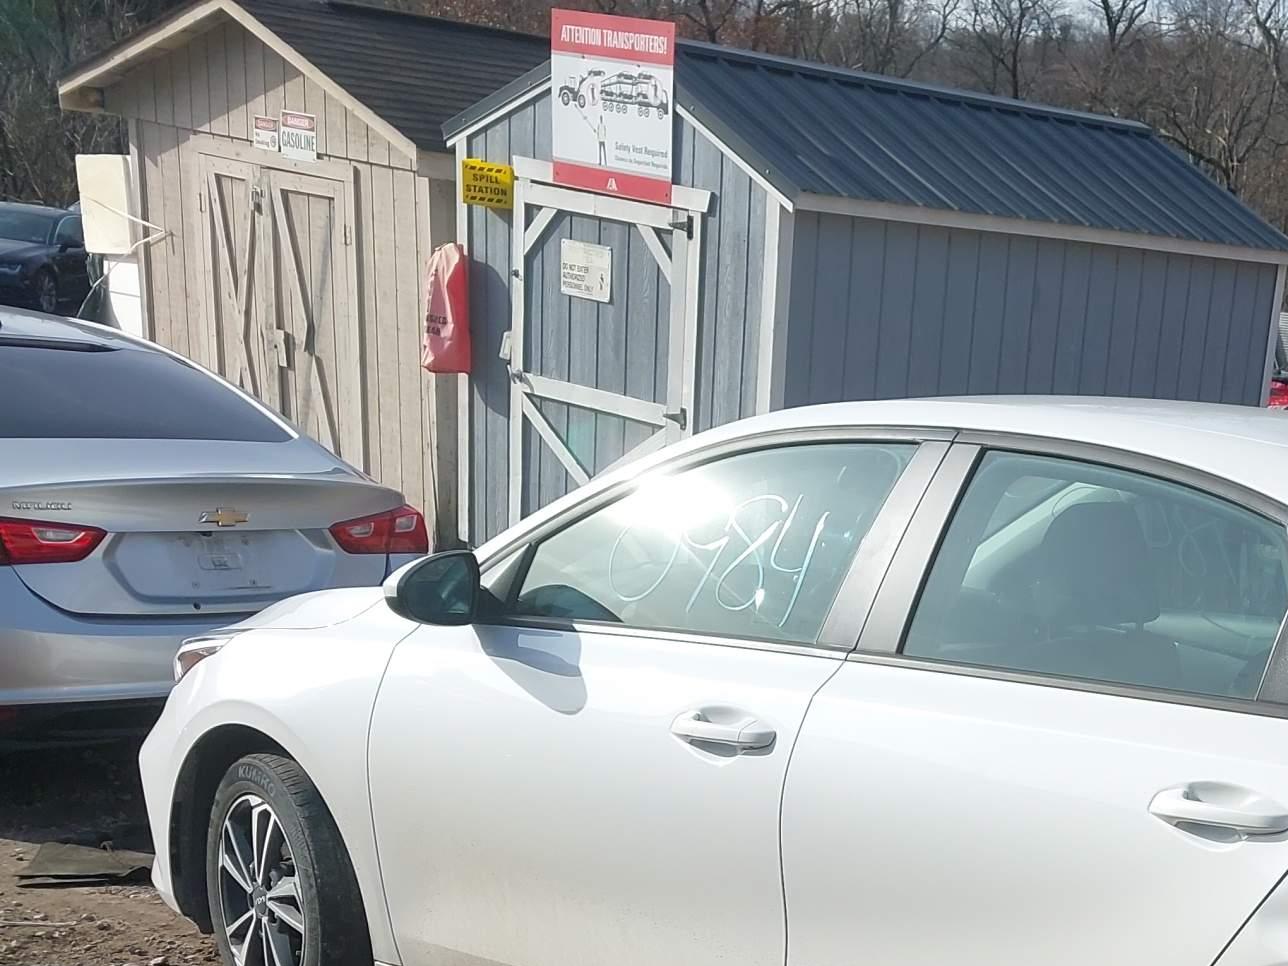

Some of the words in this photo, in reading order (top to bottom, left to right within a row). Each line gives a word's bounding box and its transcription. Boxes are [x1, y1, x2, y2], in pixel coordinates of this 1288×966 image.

[560, 24, 602, 46] ATTENTION
[602, 29, 668, 55] TRANSPORTERS!
[281, 130, 315, 152] GASOLINE
[466, 184, 508, 197] STATION
[472, 173, 501, 185] SPILL
[608, 494, 830, 629] 0984
[238, 765, 277, 798] KUMHO
